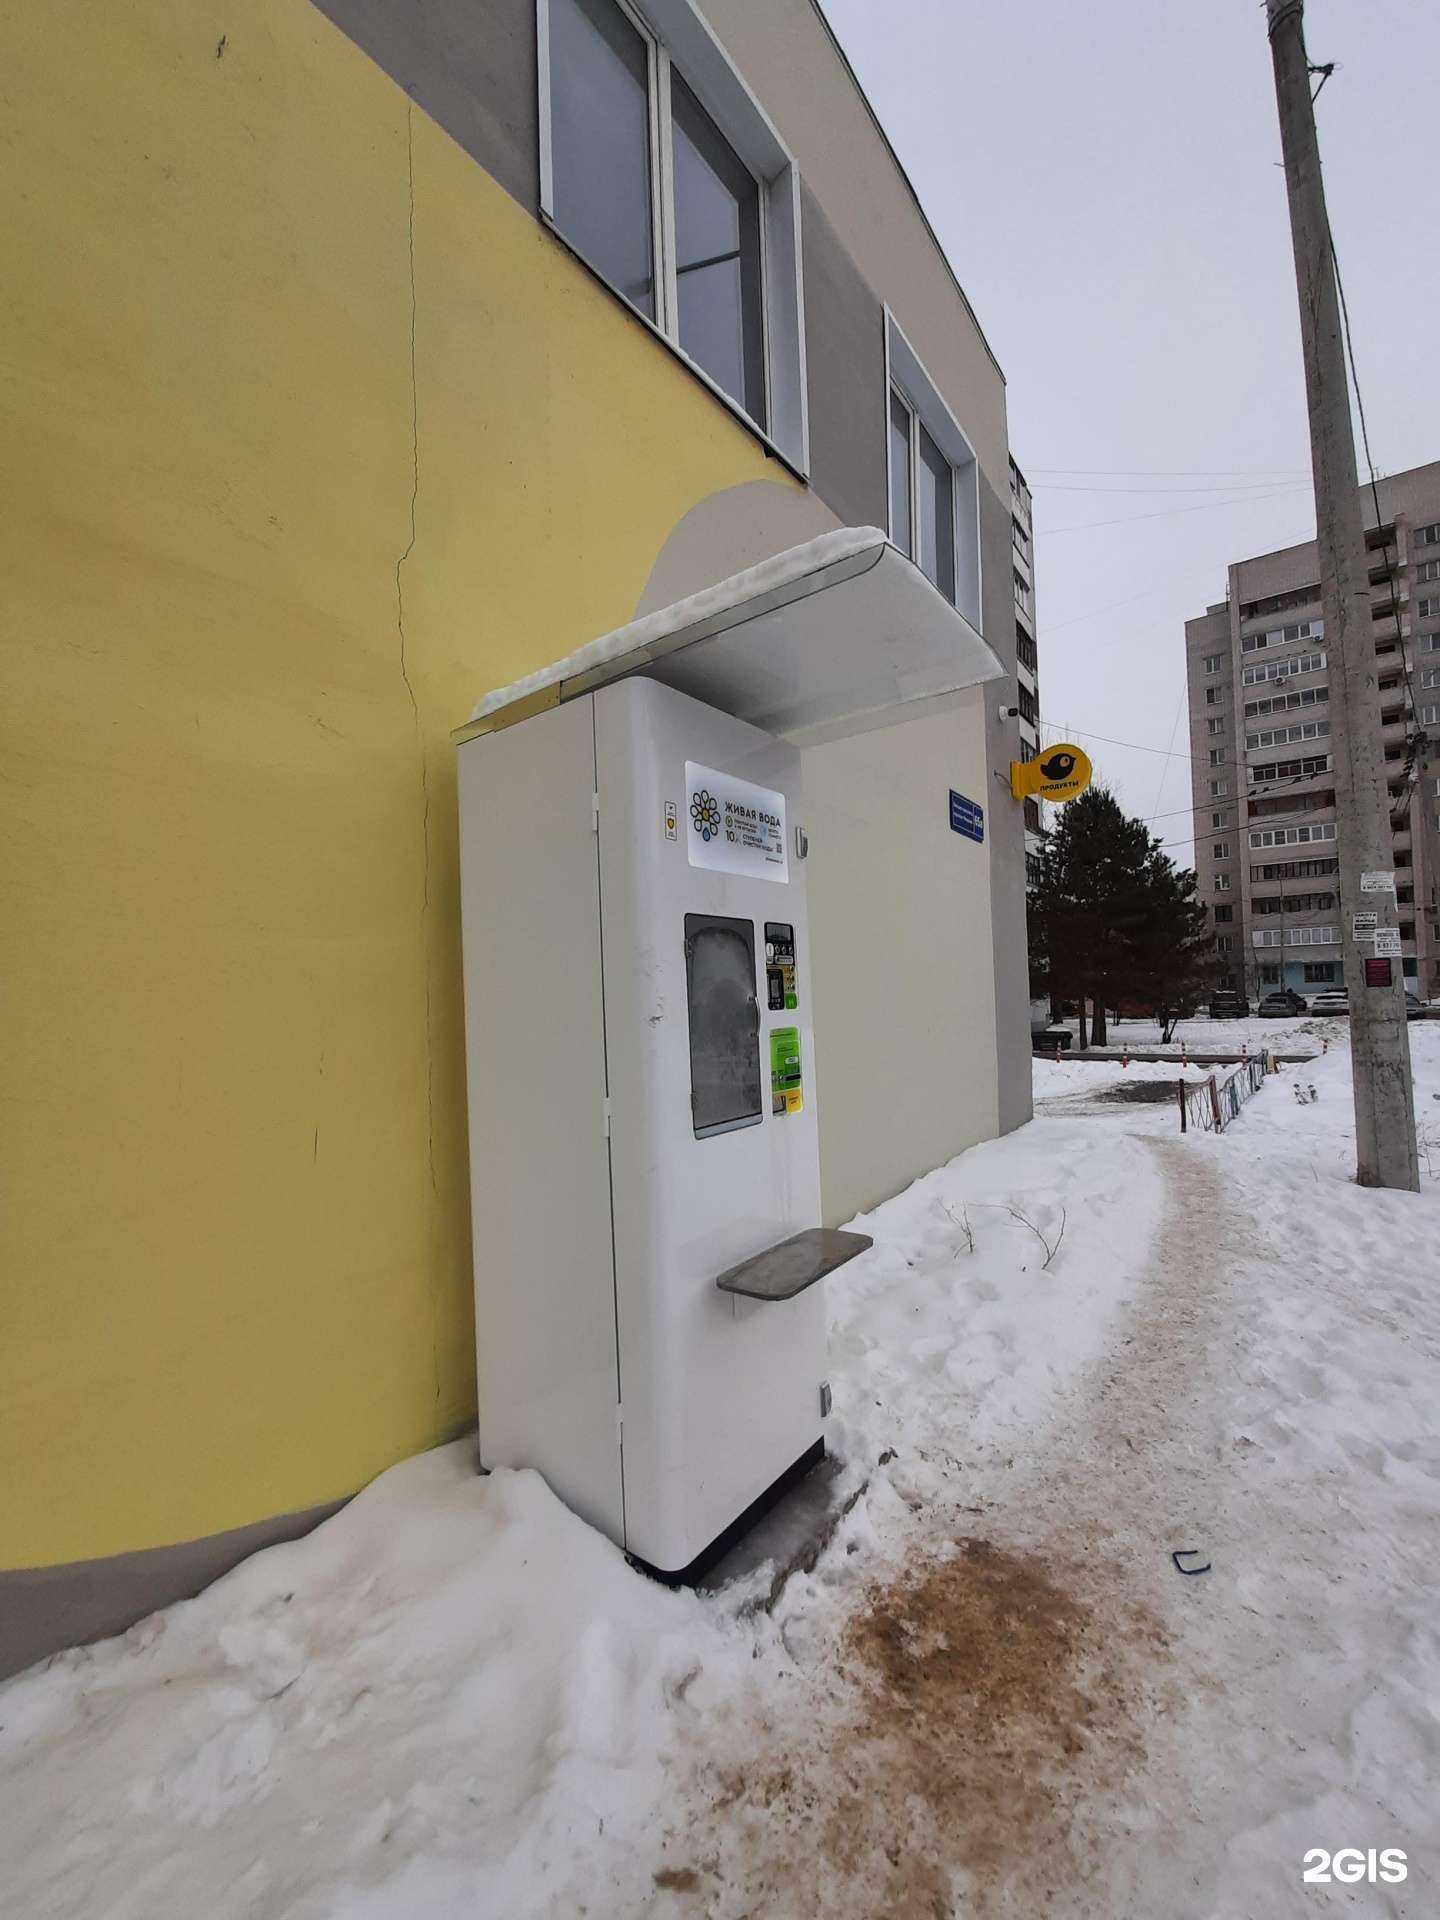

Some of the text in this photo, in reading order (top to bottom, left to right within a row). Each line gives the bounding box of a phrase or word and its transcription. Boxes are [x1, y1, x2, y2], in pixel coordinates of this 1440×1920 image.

[1039, 780, 1079, 792] ПРОДУКТЫ
[725, 801, 757, 821] ЖИВАЯ
[759, 812, 781, 827] ВОДА
[725, 830, 735, 842] 10
